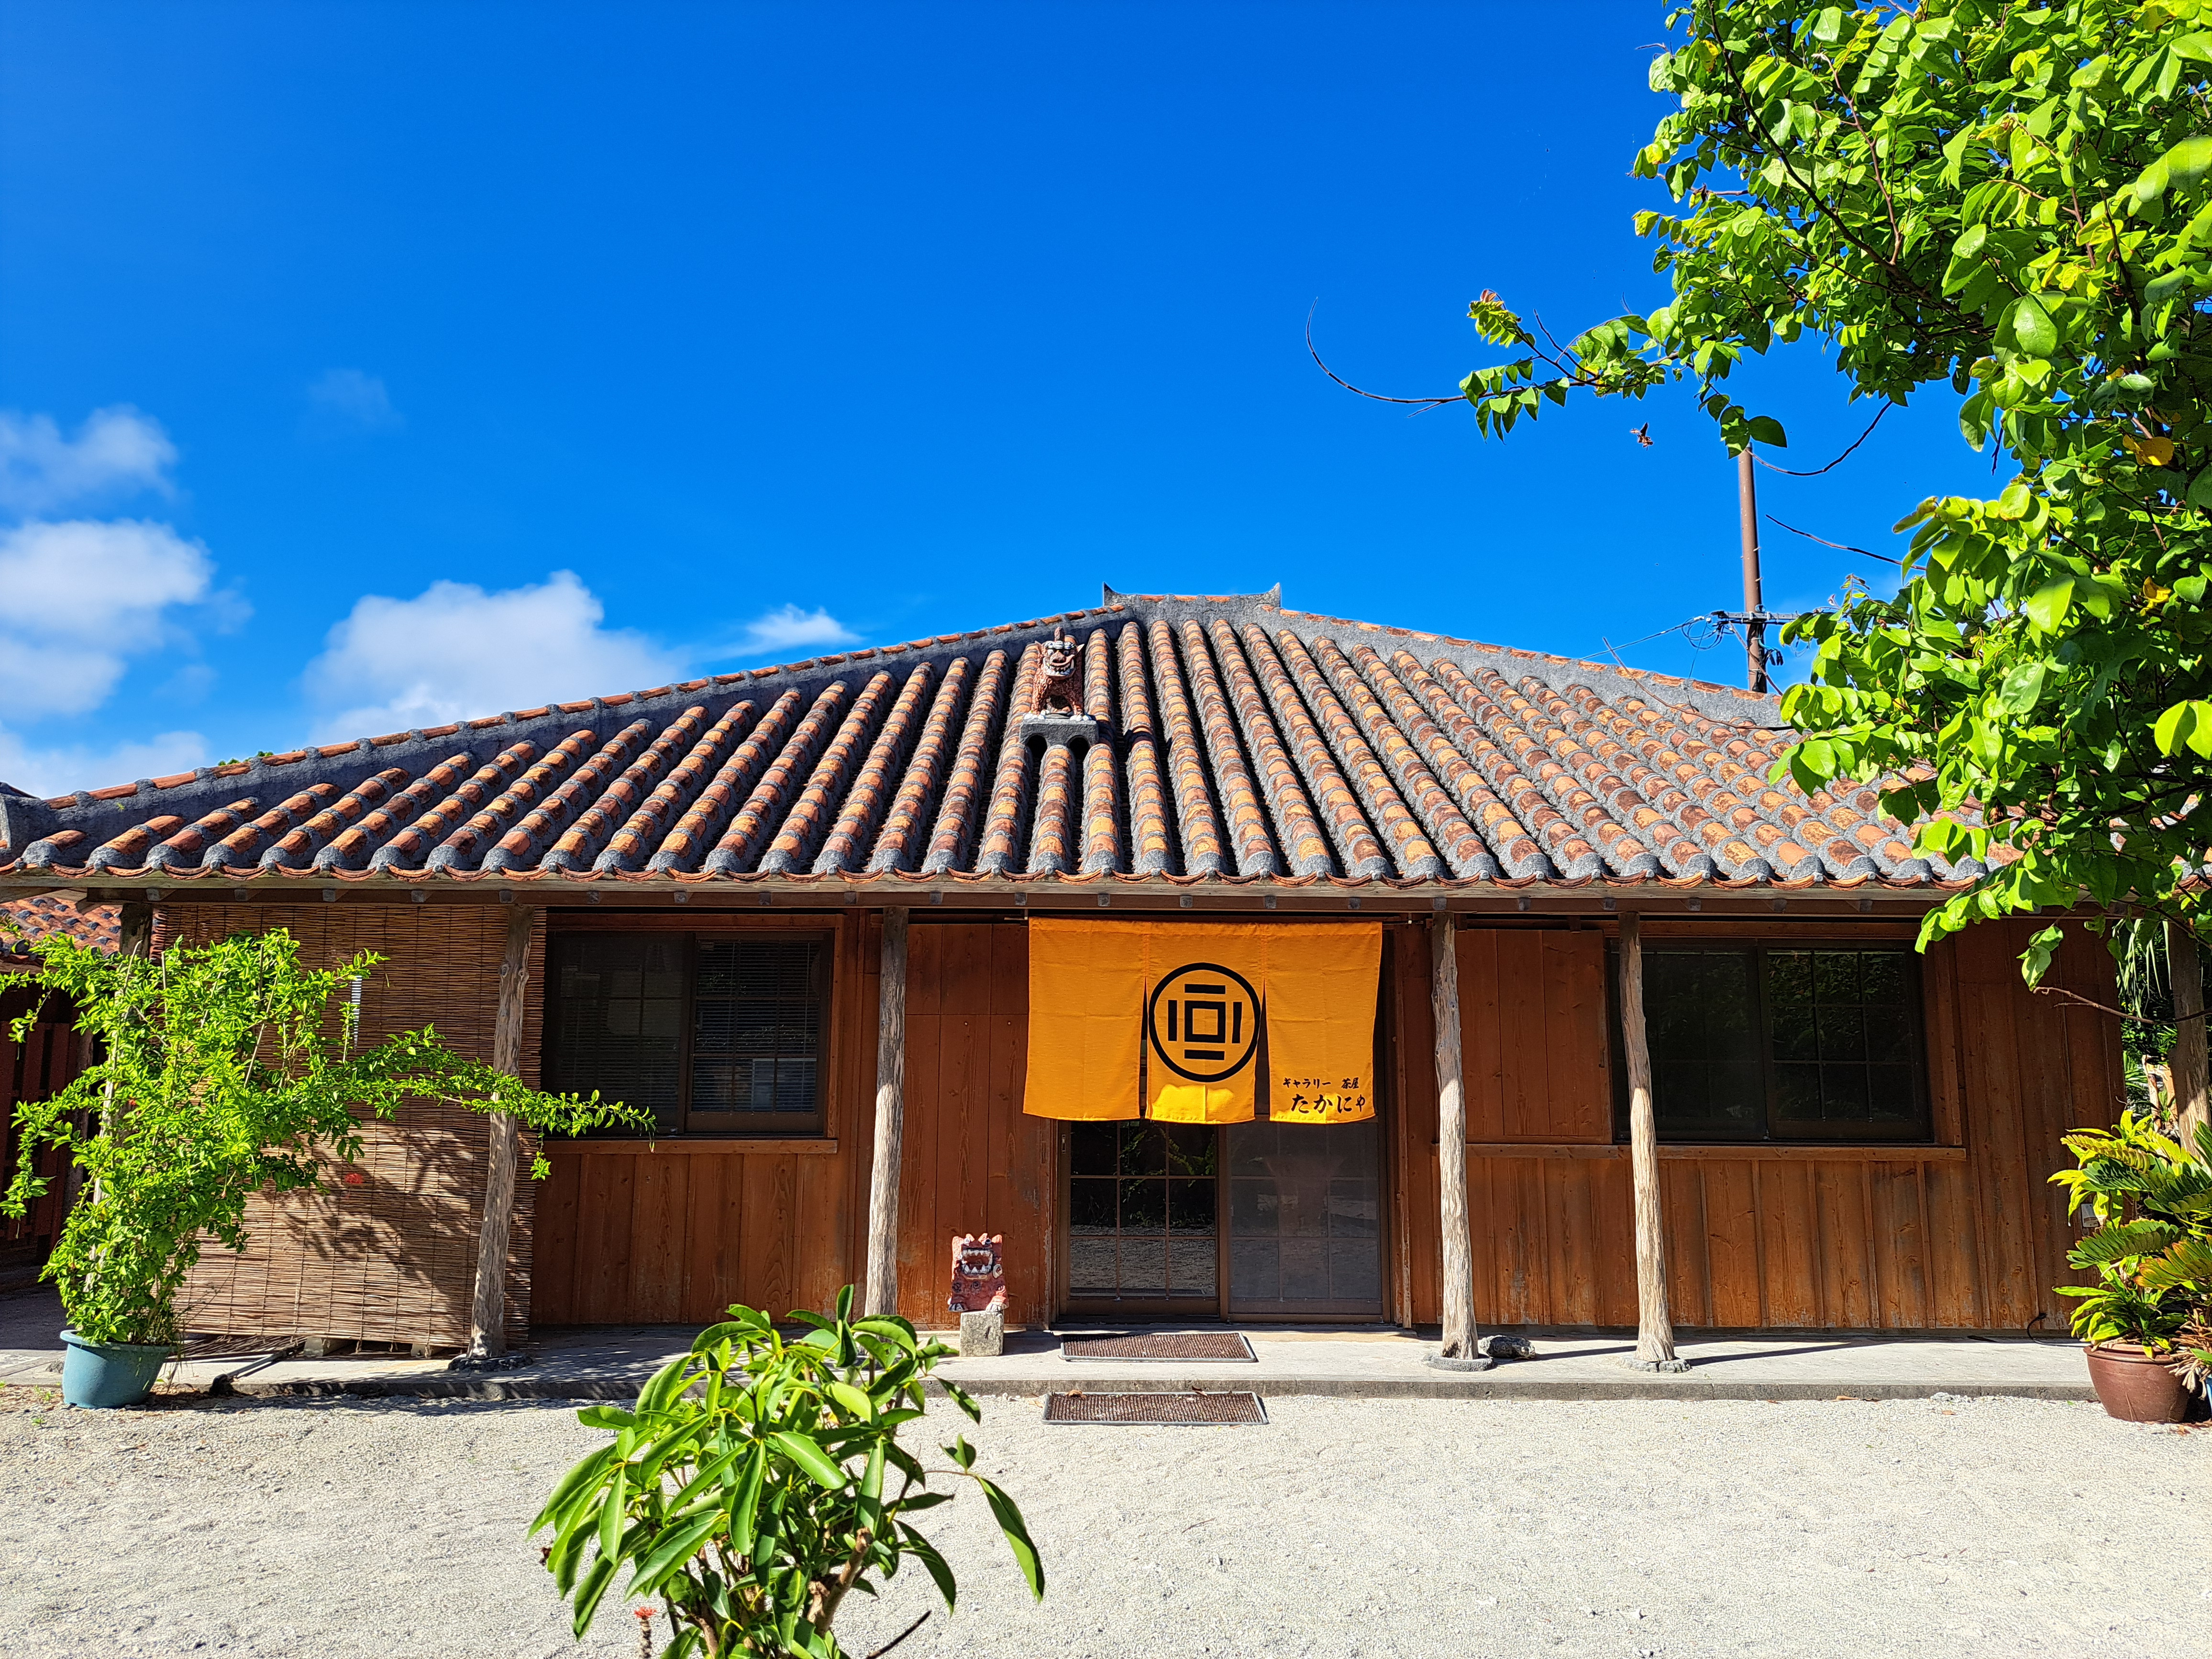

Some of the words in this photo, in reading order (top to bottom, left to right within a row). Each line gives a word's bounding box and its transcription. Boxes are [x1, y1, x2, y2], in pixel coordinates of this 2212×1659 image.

[1283, 1077, 1331, 1089] ギャラリー
[1341, 1077, 1359, 1089] 茶屋
